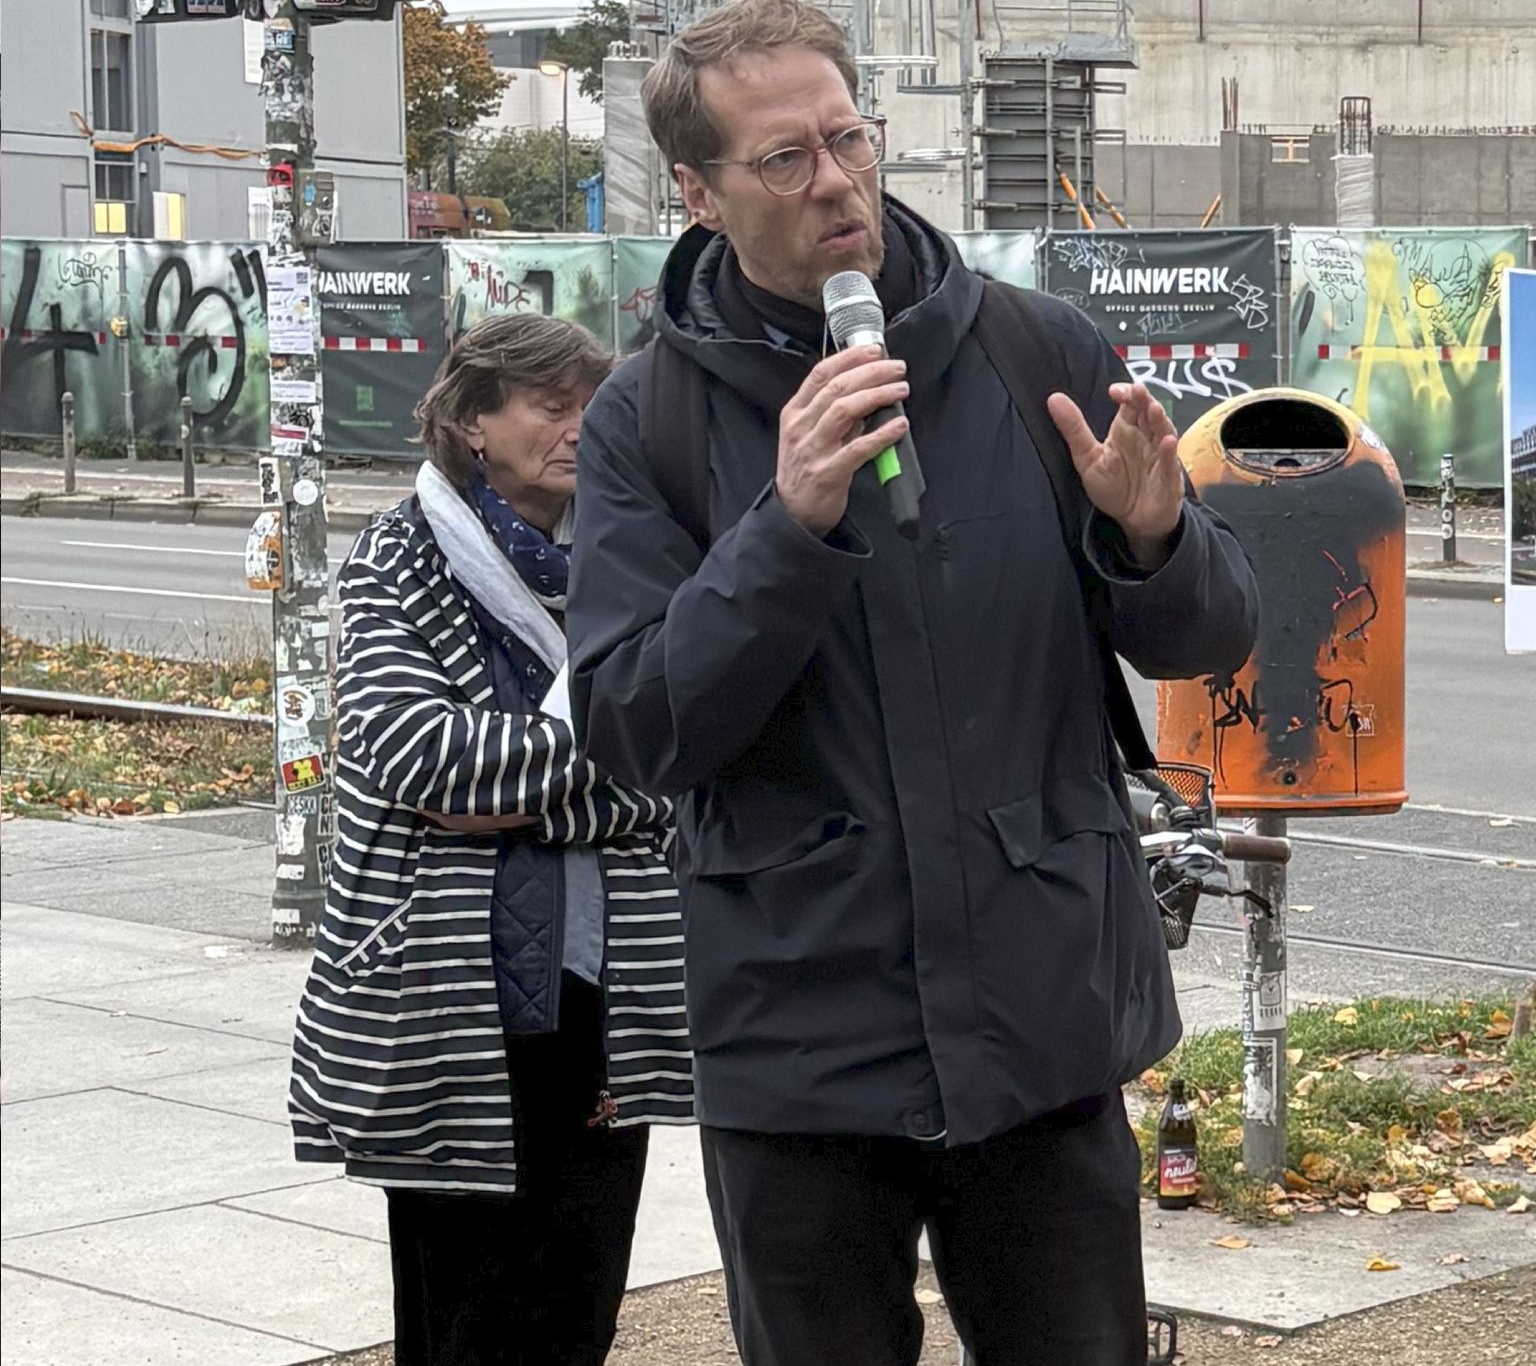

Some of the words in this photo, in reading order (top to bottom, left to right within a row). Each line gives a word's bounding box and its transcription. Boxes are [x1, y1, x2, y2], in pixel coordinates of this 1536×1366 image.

[1089, 267, 1230, 296] HAINWERK
[1105, 304, 1136, 313] OFFICE
[1183, 303, 1215, 312] BERLIN
